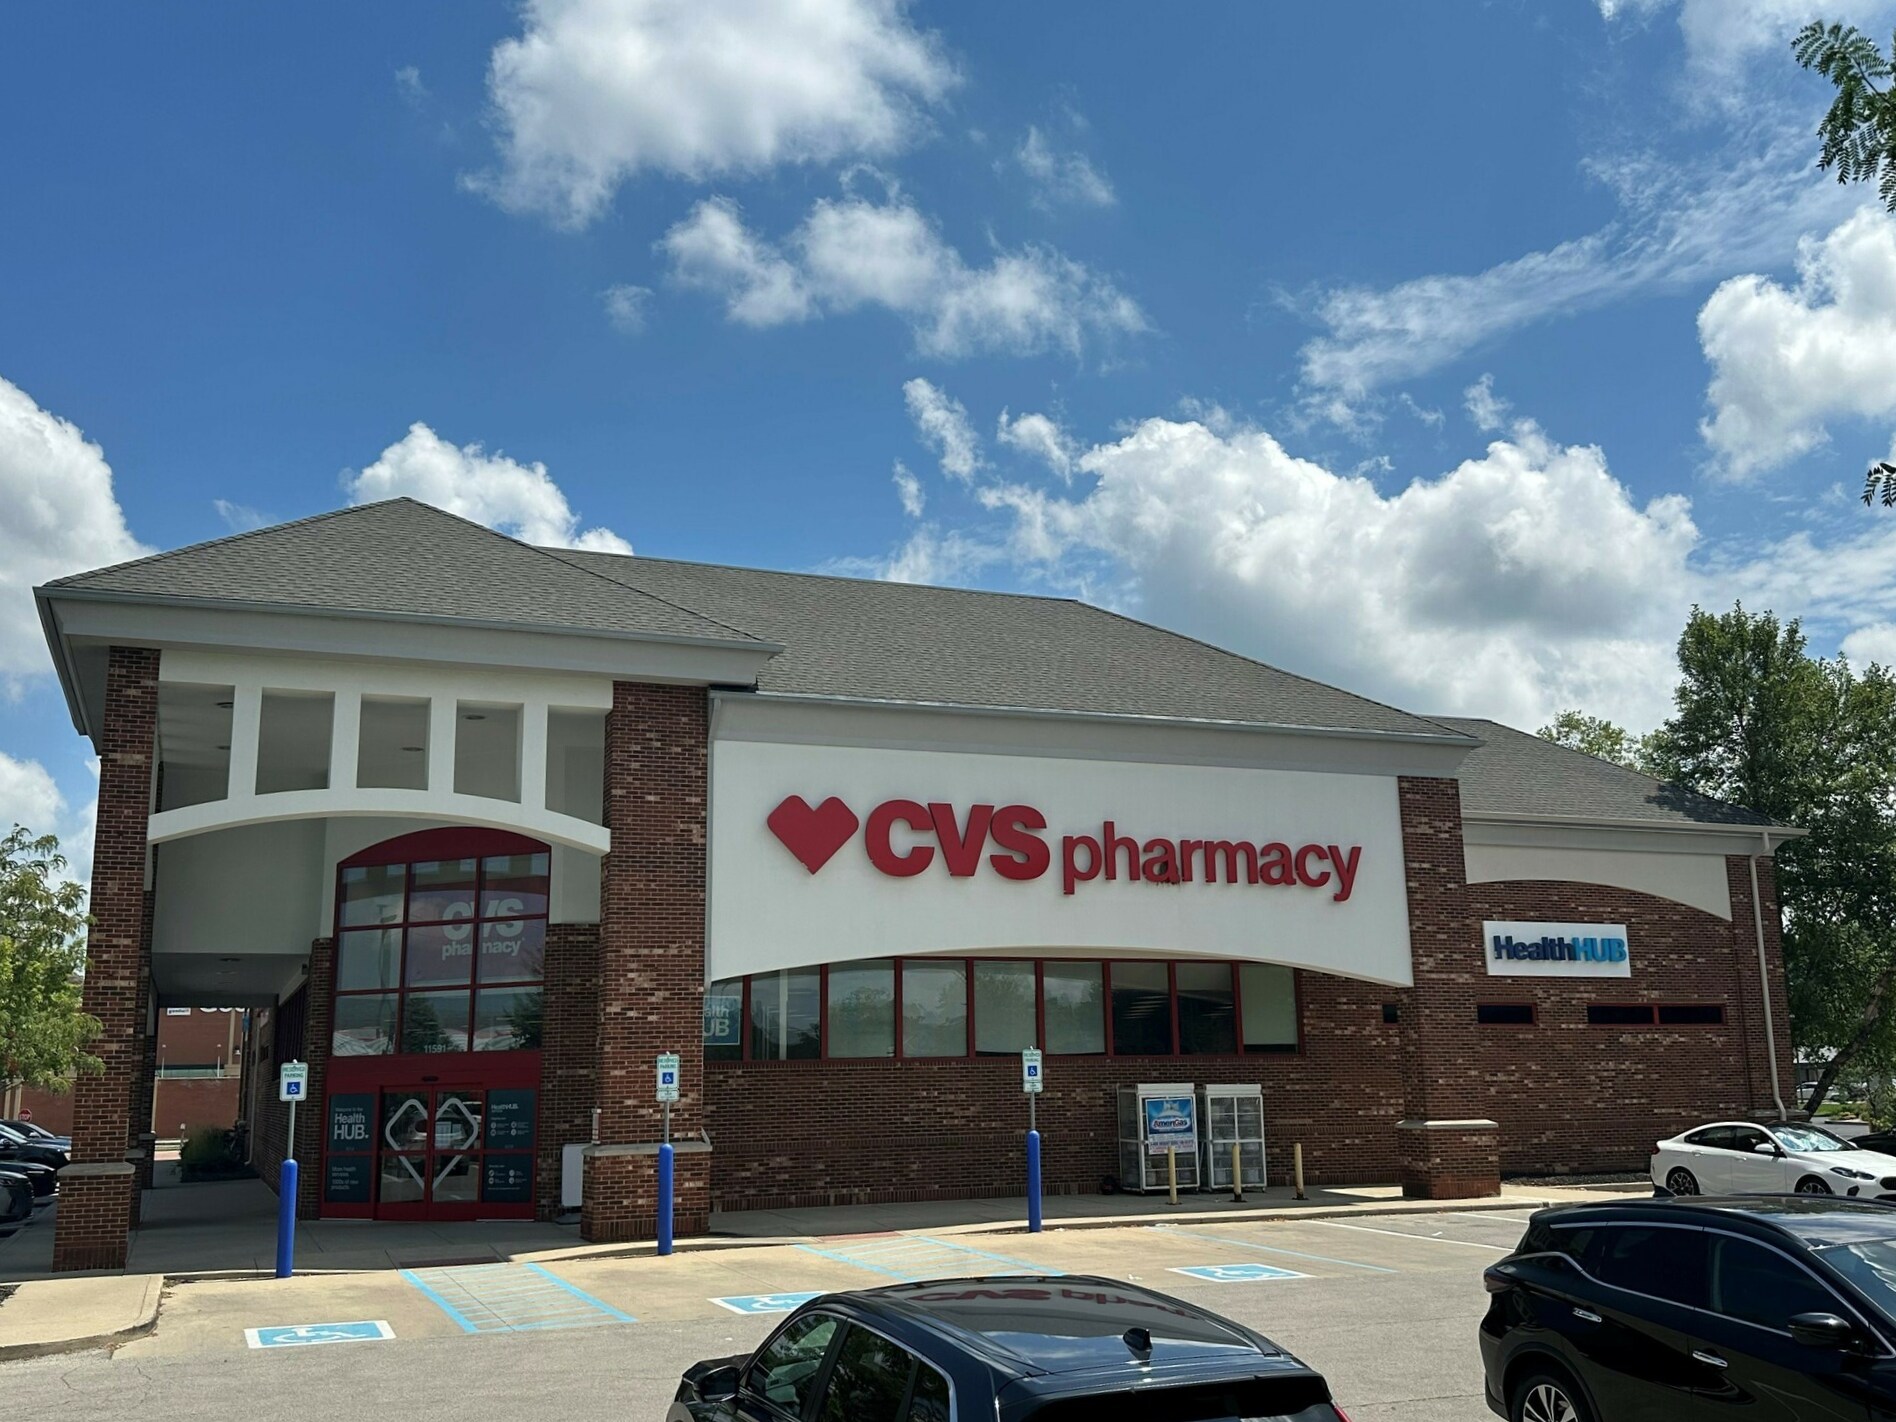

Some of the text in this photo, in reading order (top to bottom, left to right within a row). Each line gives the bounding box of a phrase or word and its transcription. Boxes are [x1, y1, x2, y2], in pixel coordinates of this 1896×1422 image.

[865, 799, 1362, 902] CVS pharmacy
[442, 898, 524, 941] CVS
[441, 940, 521, 961] phamacy
[1493, 935, 1627, 962] HealthHUB
[703, 1018, 730, 1037] UB
[424, 1044, 447, 1053] 11591
[334, 1113, 366, 1124] Health
[334, 1124, 369, 1140] HUB.
